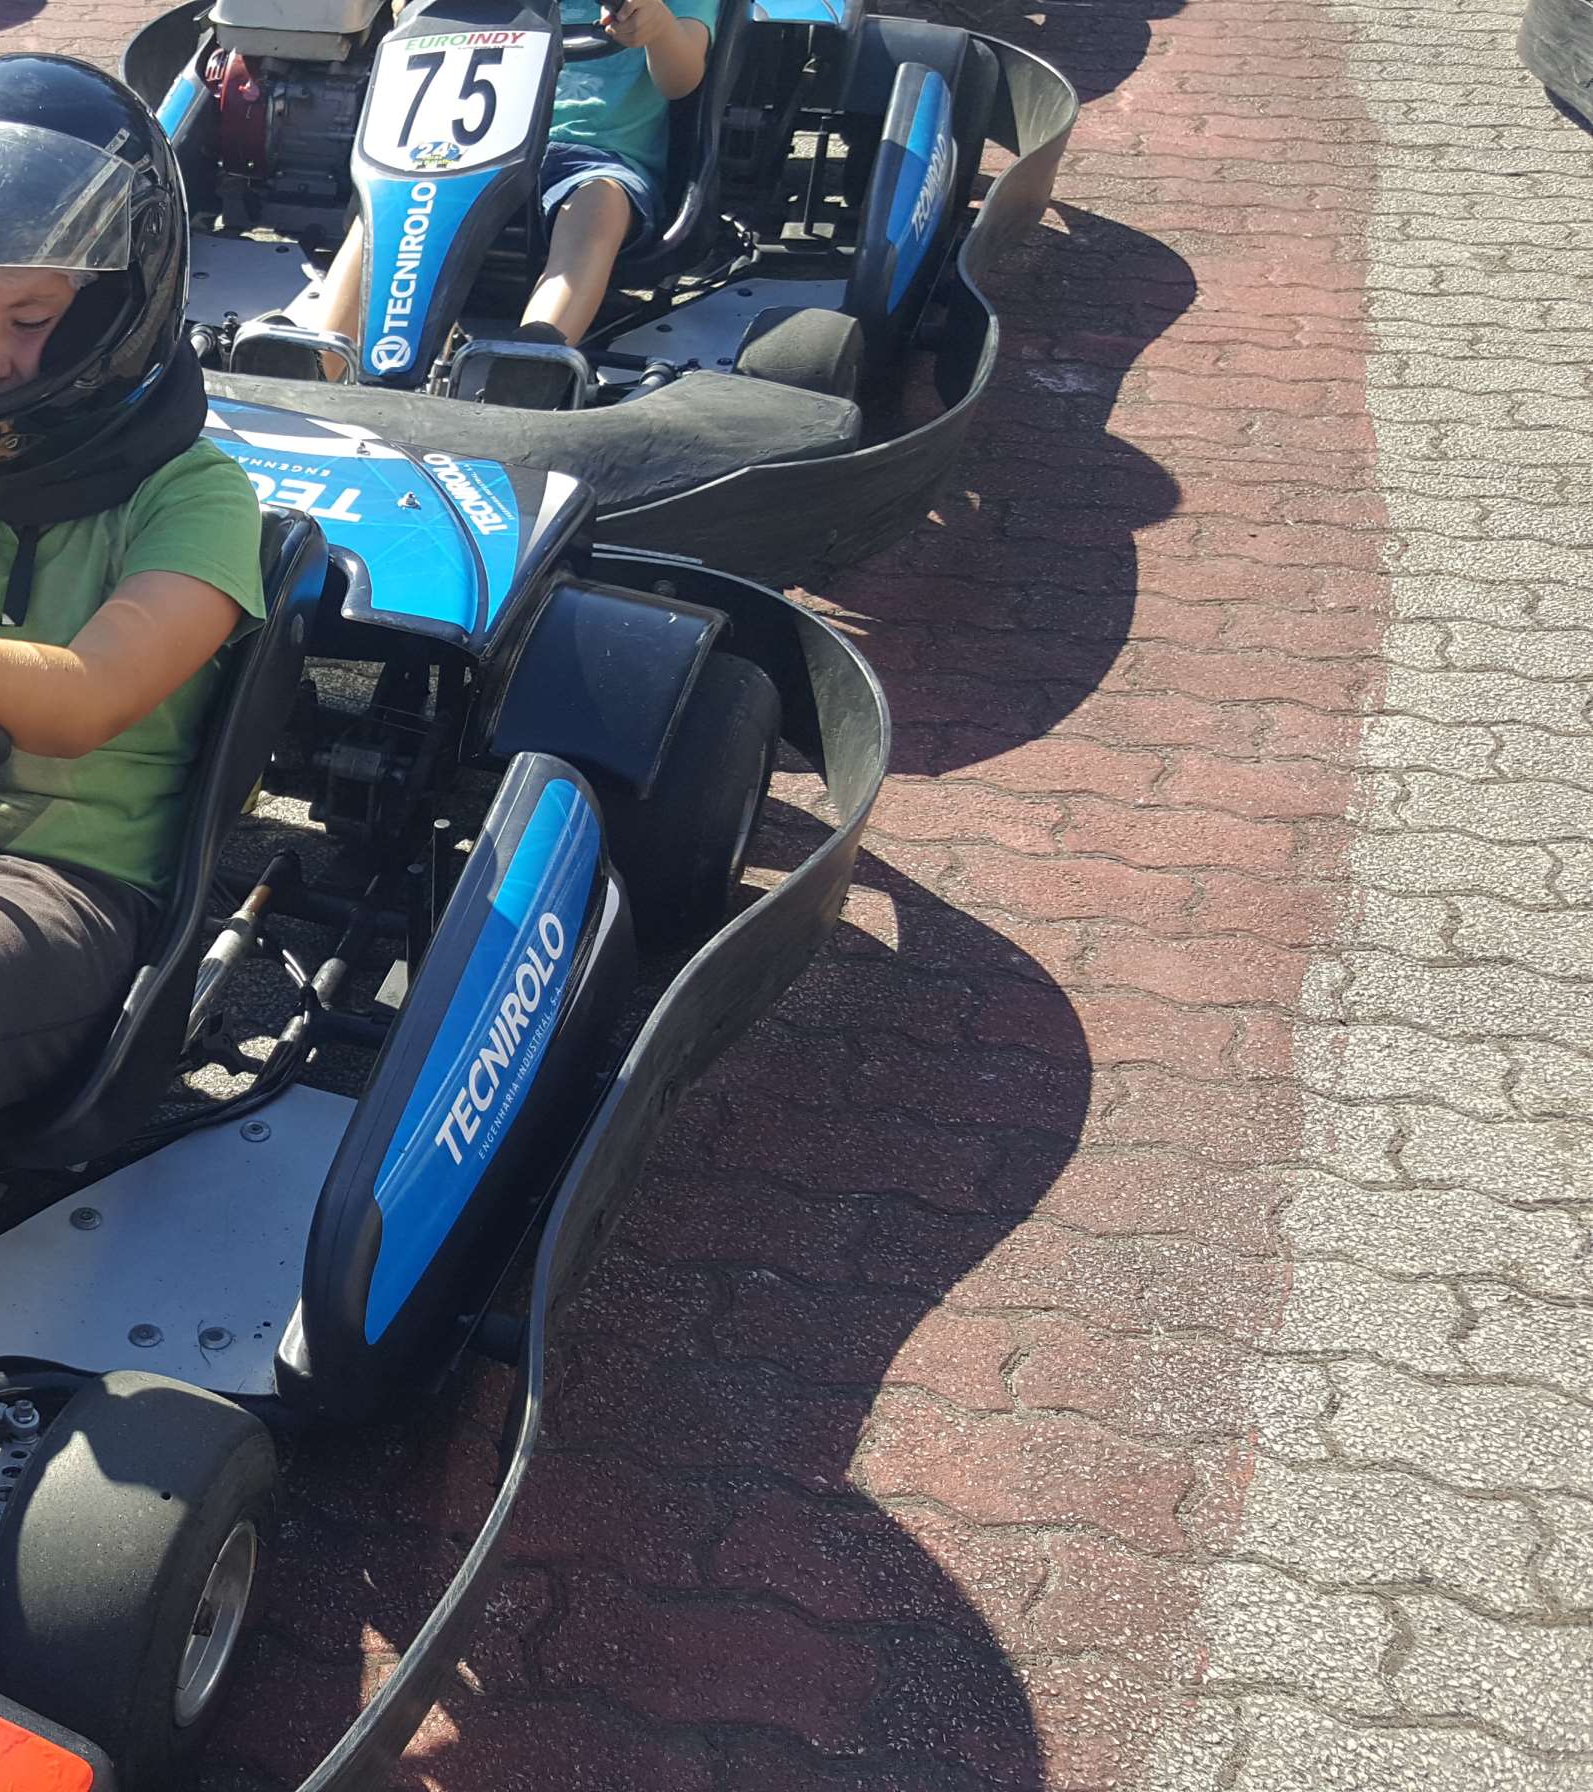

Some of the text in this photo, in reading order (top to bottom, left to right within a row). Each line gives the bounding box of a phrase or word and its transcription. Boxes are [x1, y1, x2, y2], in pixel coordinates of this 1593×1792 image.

[405, 32, 526, 51] EUROINDY
[397, 48, 504, 148] 75
[383, 181, 437, 334] TECNIROLO
[423, 453, 508, 535] TECNIROLO
[435, 911, 565, 1166] TECNIROLO
[478, 1082, 519, 1161] ENGENHARIA
